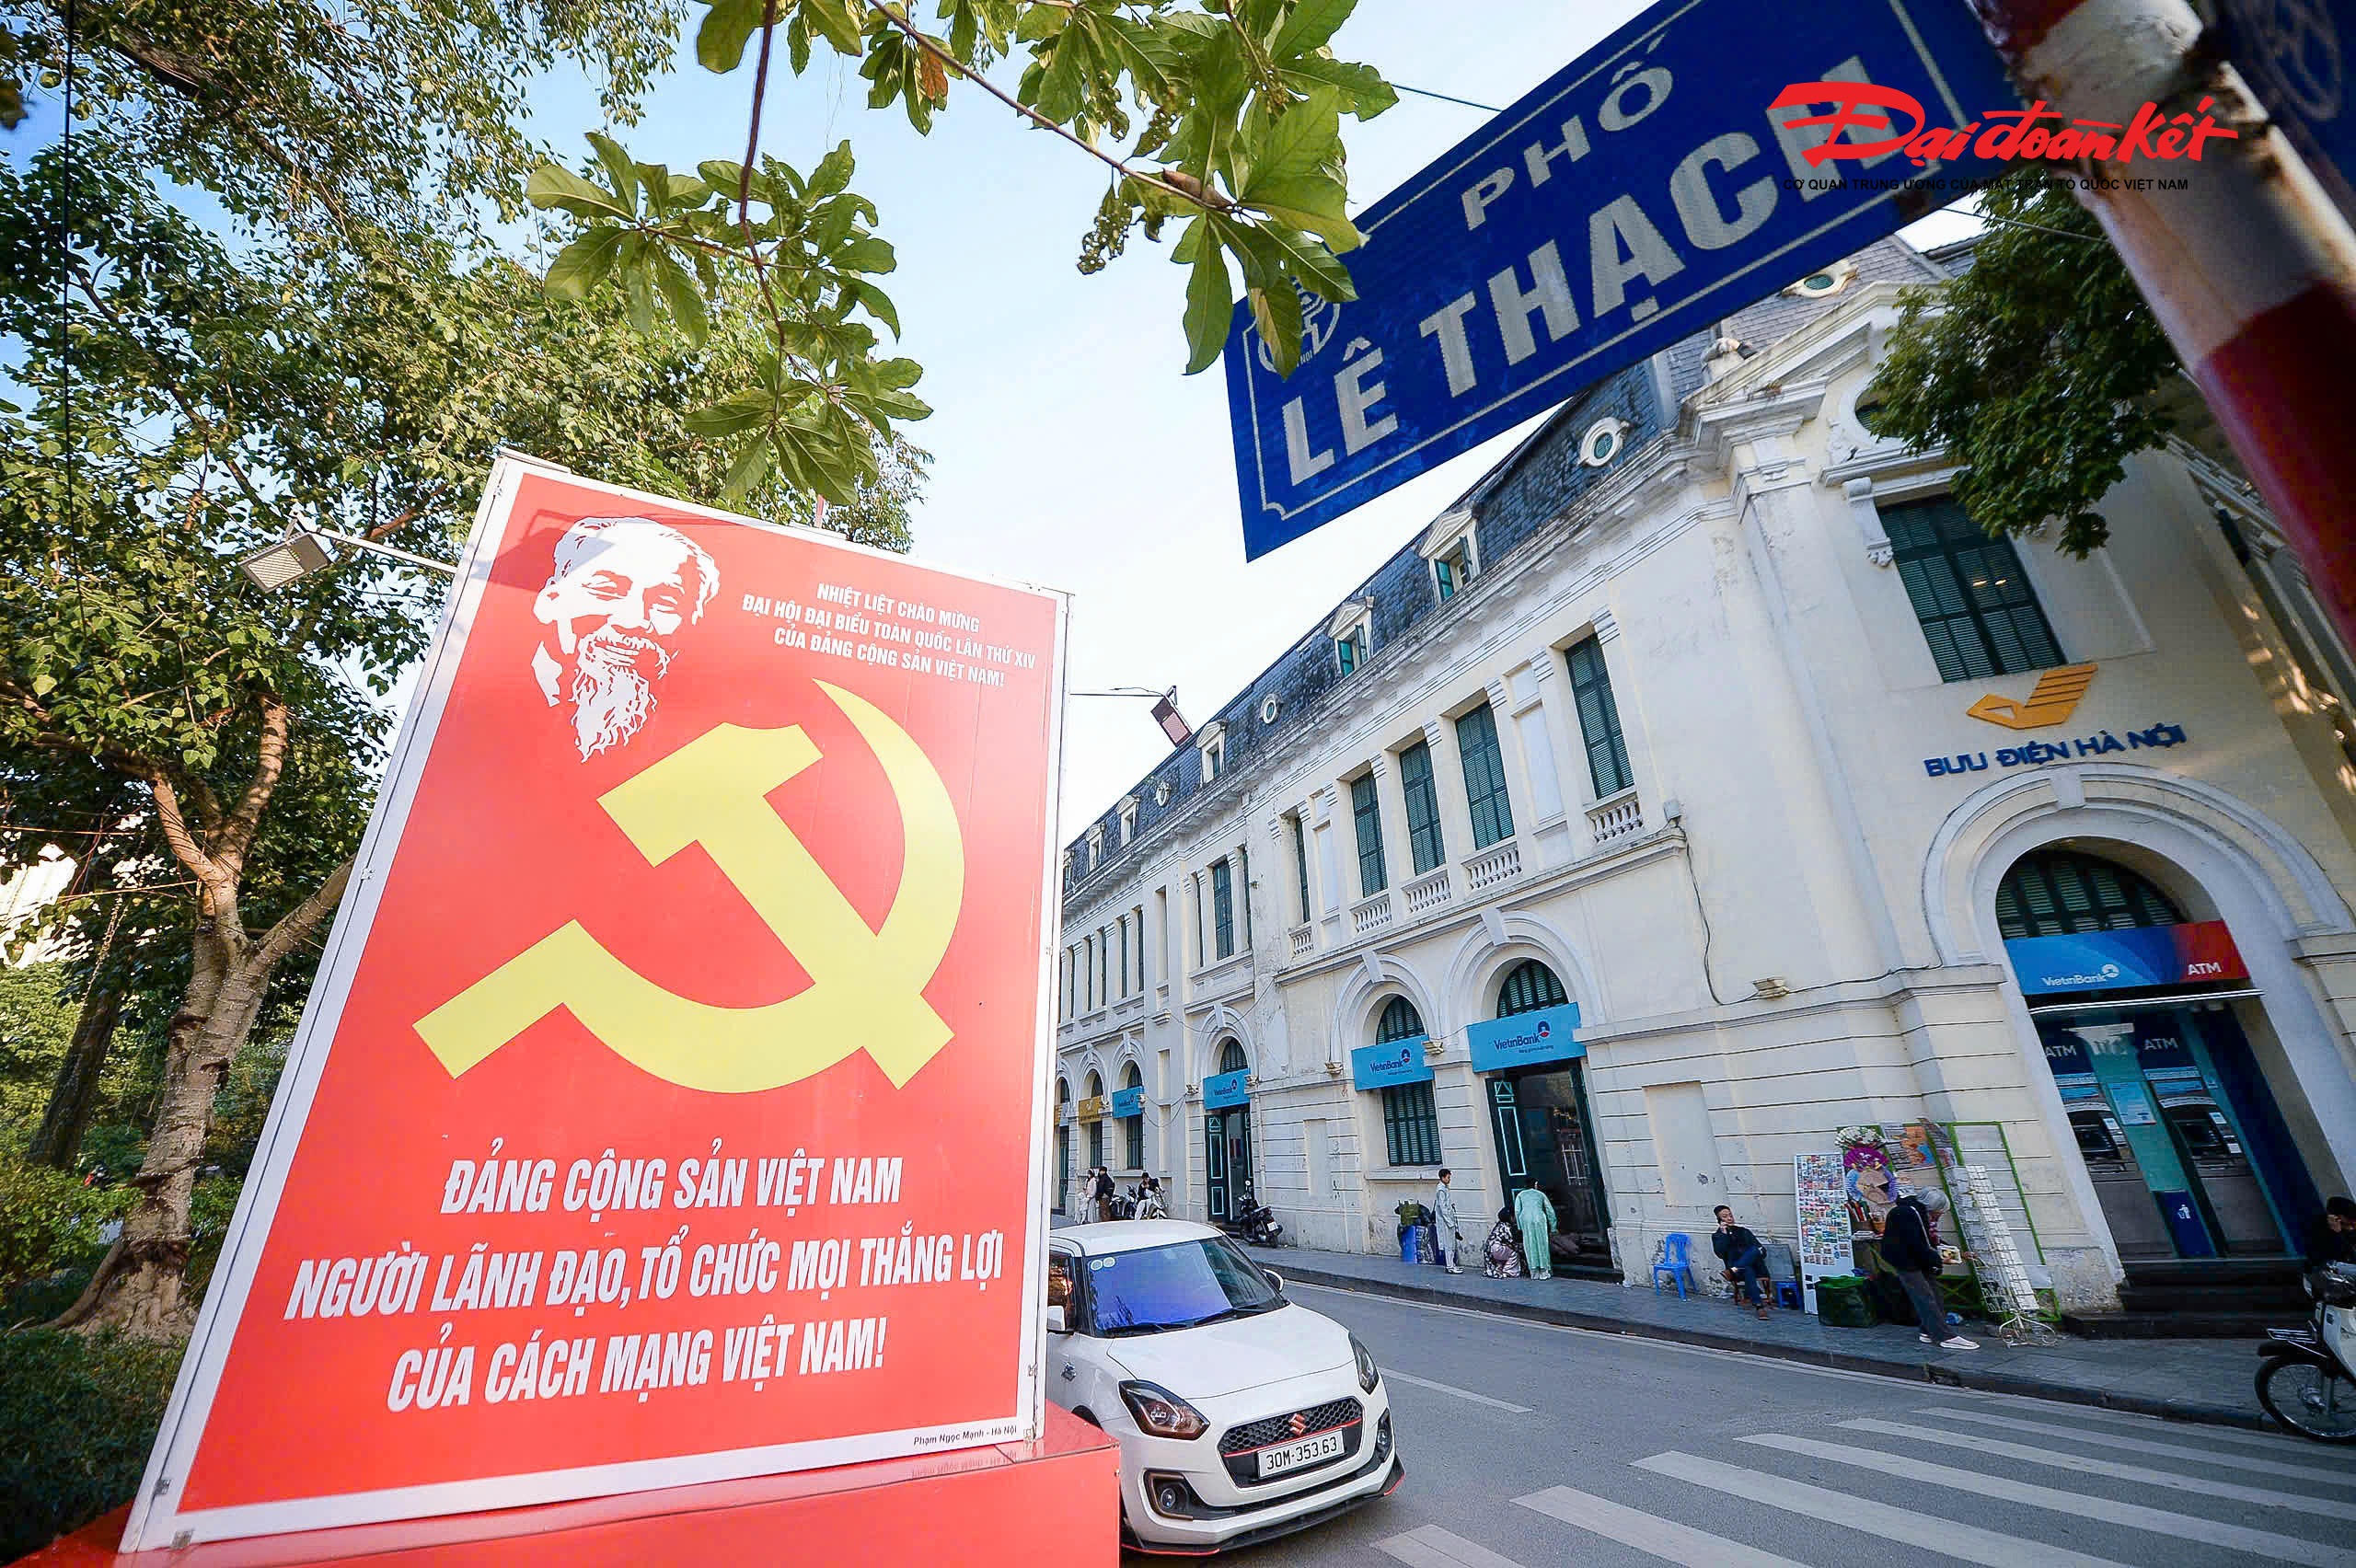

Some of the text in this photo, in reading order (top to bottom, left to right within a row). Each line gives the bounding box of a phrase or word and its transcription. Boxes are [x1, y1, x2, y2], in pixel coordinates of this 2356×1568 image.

[1461, 33, 1673, 231] PHỐ
[1280, 55, 1898, 487] LÊ THẠCH
[742, 594, 771, 617] ĐẠI
[773, 600, 802, 624] HỘI
[803, 606, 833, 629] ĐẠI
[834, 611, 870, 636] BIỂU
[873, 621, 912, 644] TOÀN
[914, 629, 953, 652] QUỐC
[986, 644, 1013, 664] THỨ
[1013, 652, 1036, 670] XIV
[816, 582, 980, 633] NHIỆT LIỆT CHÀO MỪNG
[774, 623, 1005, 688] CỦA ĐẢNG CỘNG SẢN VIỆT NAM!
[1995, 740, 2071, 767] ĐIỆN
[2073, 730, 2126, 756] HÀ
[2127, 722, 2187, 749] NỘI
[2187, 962, 2223, 975] ATM
[2045, 1044, 2077, 1057] ATM
[2143, 1037, 2178, 1051] ATM
[441, 1137, 904, 1223] ĐẢNG CỘNG SẢN VIỆT NAM
[283, 1219, 1004, 1320] NGƯỜI LÃNH ĐẠO, TỔ CHỨC MỌI THẮNG LỢI
[387, 1313, 887, 1412] CỦA CÁCH MẠNG VIỆT NAM!
[913, 1435, 937, 1447] Phạm
[939, 1434, 961, 1445] Ngọc
[963, 1430, 984, 1441] Mạnh
[1004, 1425, 1017, 1435] Nội
[1265, 1436, 1337, 1470] 30M-353.63
